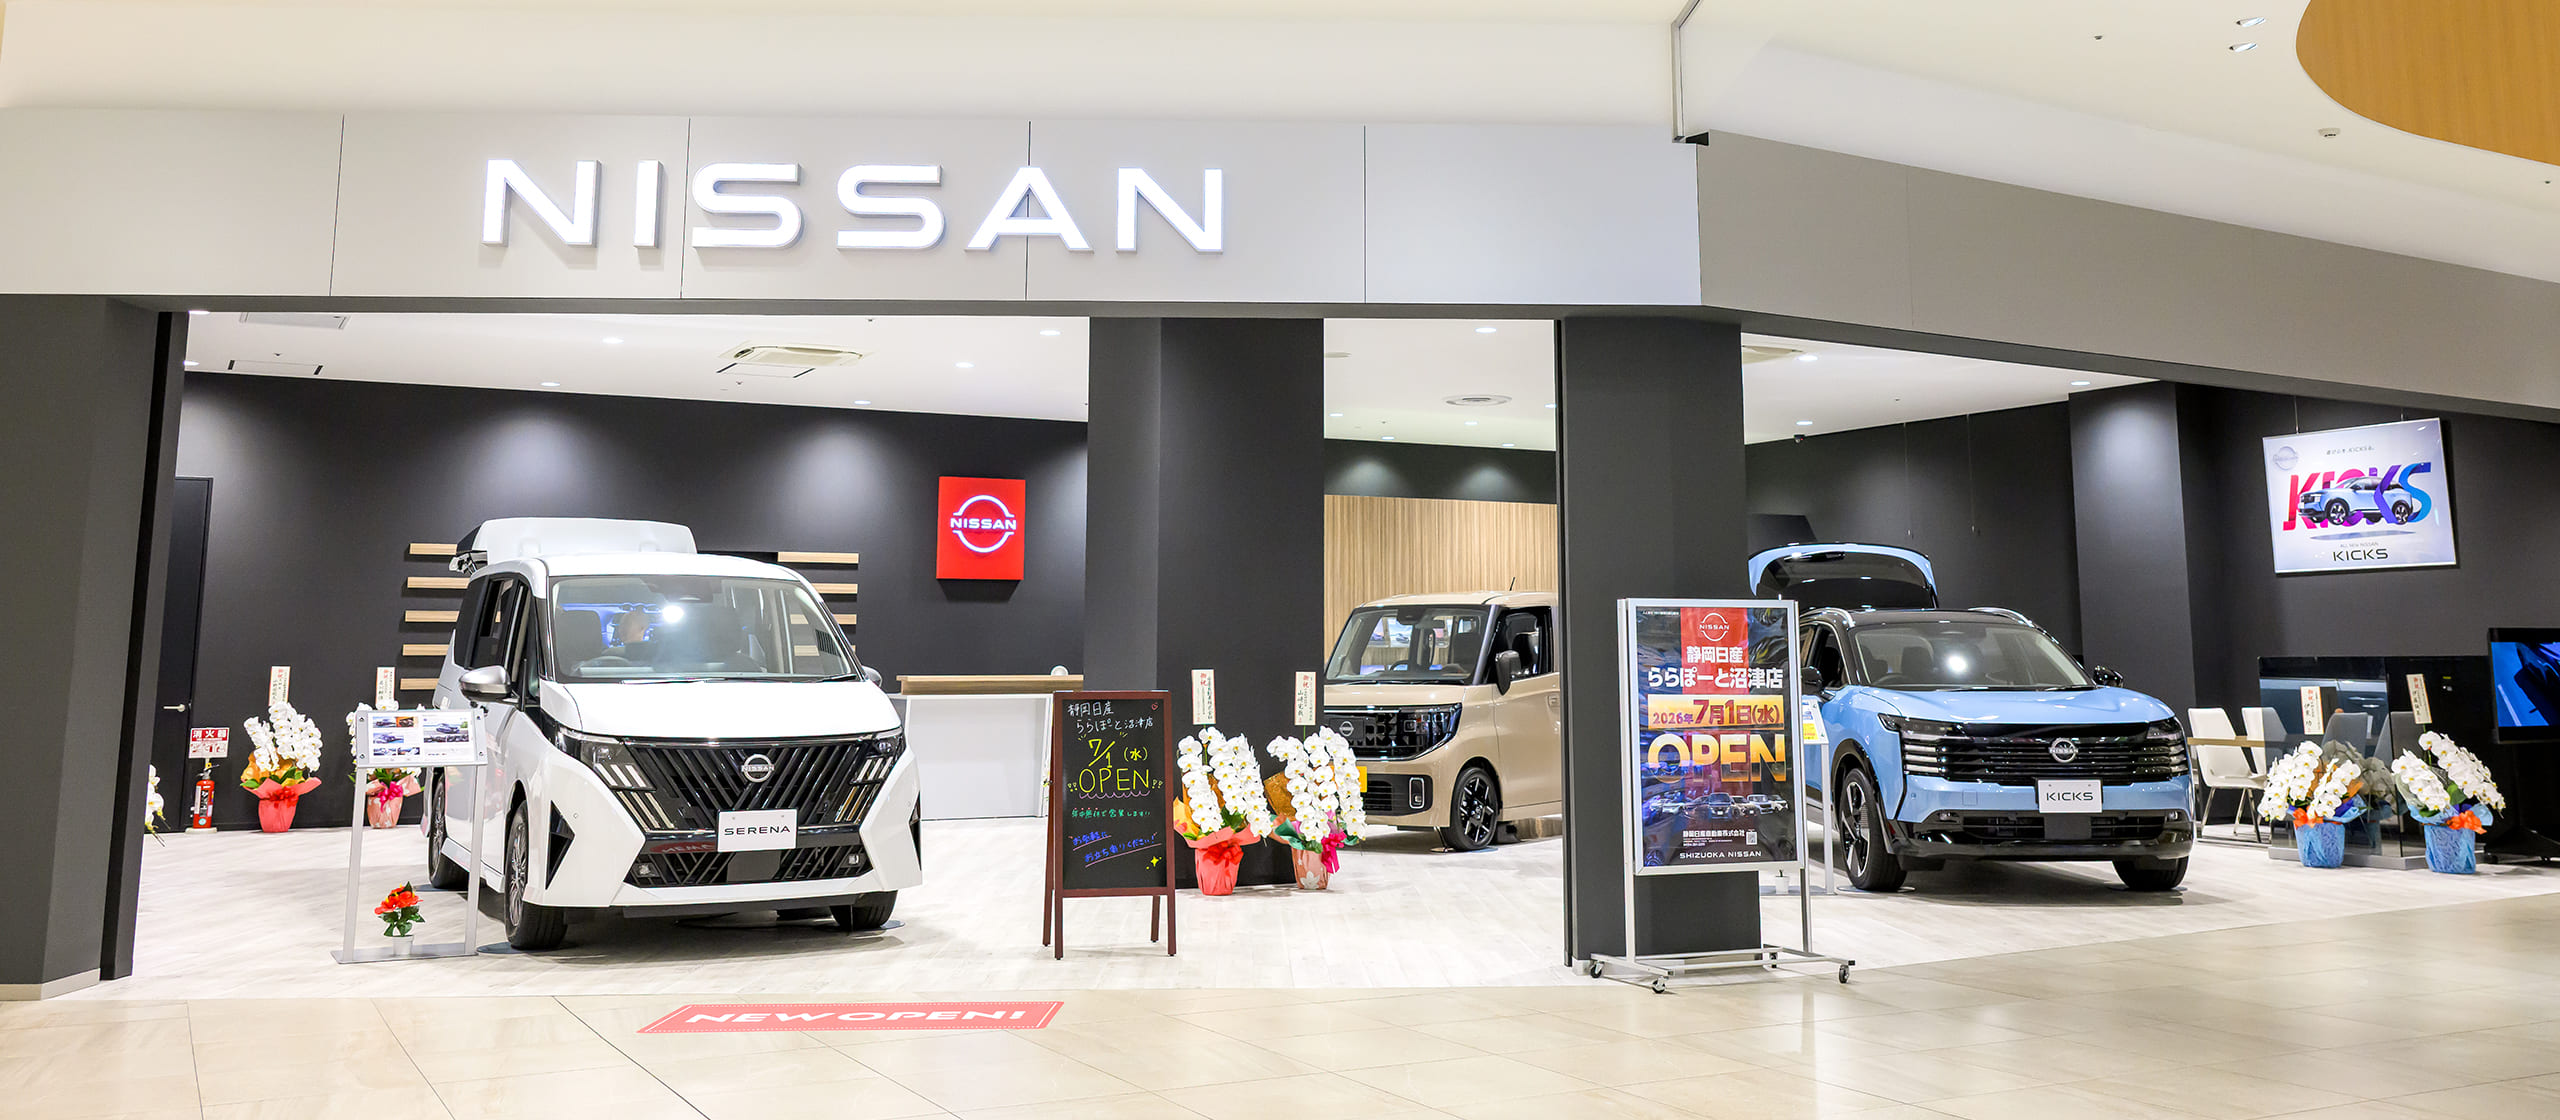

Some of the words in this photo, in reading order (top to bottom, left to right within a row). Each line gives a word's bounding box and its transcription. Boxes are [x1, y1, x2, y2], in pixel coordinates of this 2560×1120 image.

[480, 157, 1223, 254] NISSAN
[950, 517, 1017, 530] NISSAN
[2333, 548, 2389, 562] KICKS
[1686, 645, 1744, 663] 静岡日産
[1648, 667, 1784, 689] ららぽーと沼津店
[1067, 700, 1114, 717] 静岡日産
[1653, 699, 1780, 725] 2026年7月1日(水)
[1076, 716, 1154, 734] ららぽーと沼津店
[1088, 738, 1116, 769] 7/1
[1647, 733, 1787, 784] OPEN
[741, 763, 775, 773] NISSAN
[2046, 792, 2094, 801] KICKS
[724, 825, 791, 836] SERENA
[1679, 851, 1725, 859] SHIZUOKA
[1727, 850, 1762, 858] NISSAN
[685, 1012, 836, 1023] NEW
[837, 1010, 1026, 1022] OPEN!
